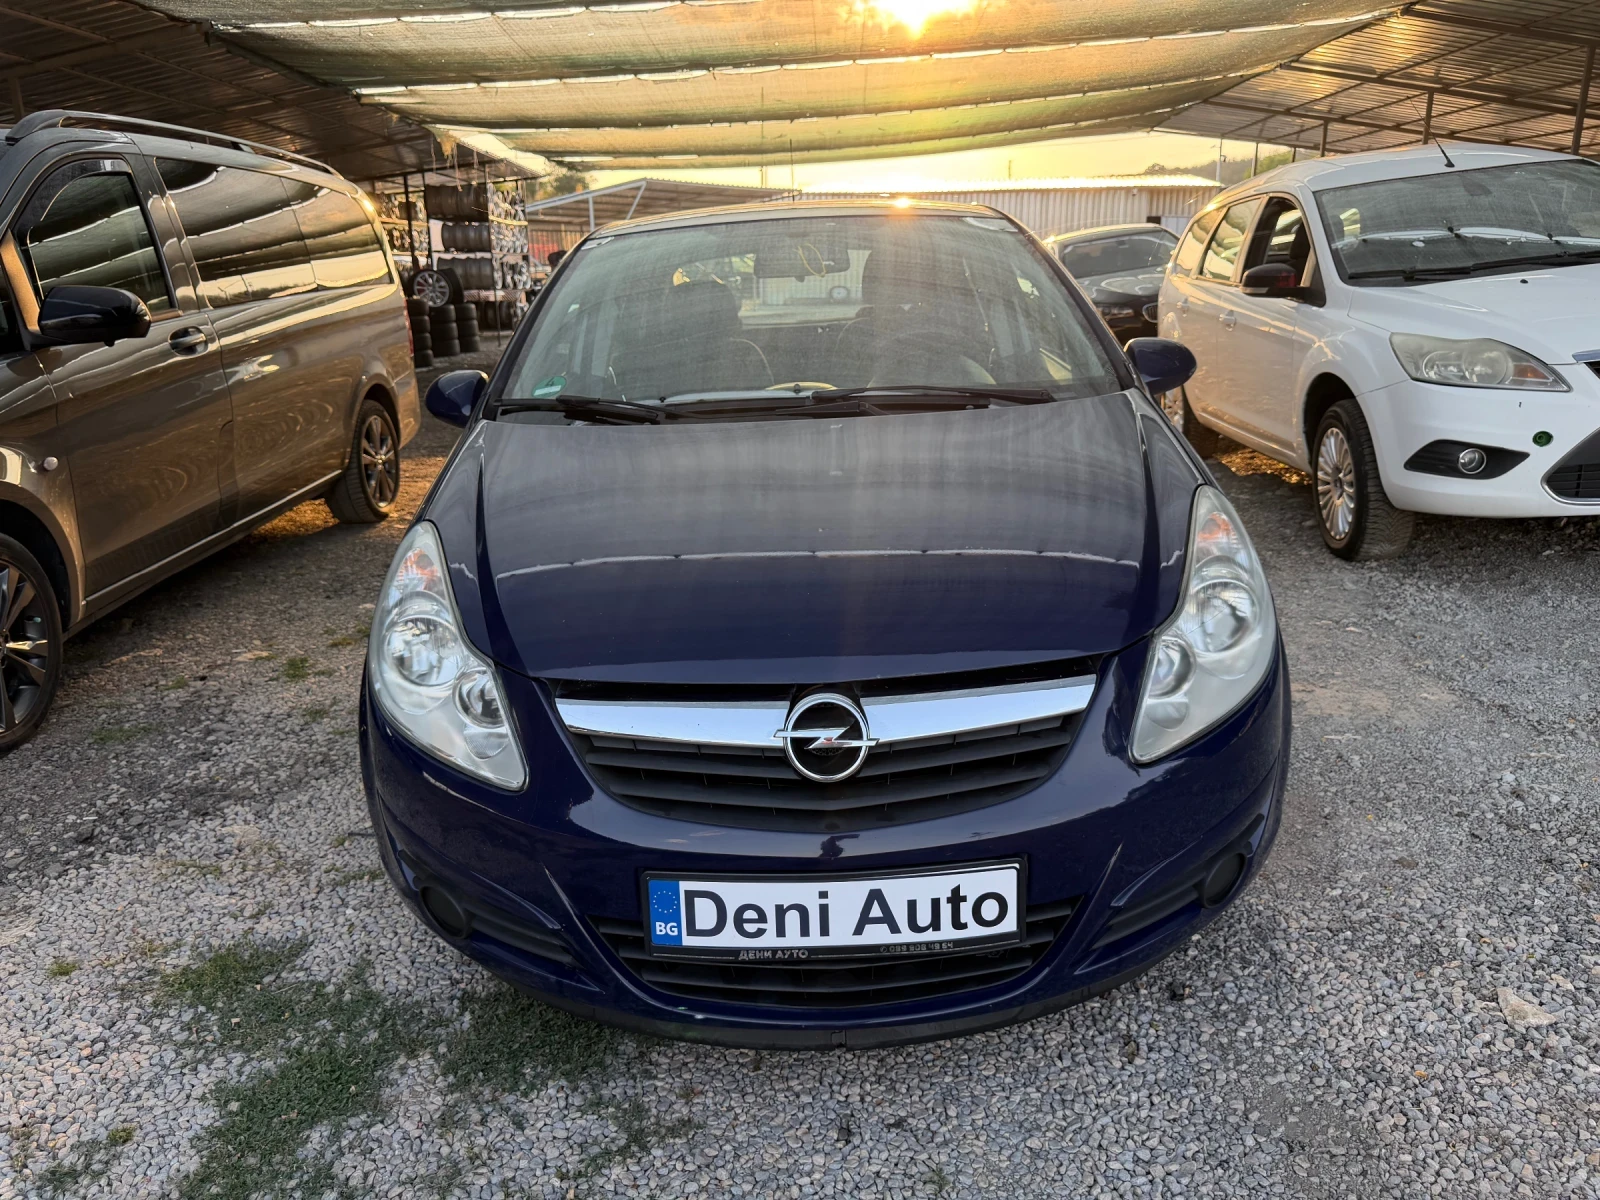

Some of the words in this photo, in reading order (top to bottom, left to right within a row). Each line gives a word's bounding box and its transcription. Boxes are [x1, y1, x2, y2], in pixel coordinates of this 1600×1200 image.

[683, 890, 830, 939] Deni
[851, 883, 1009, 936] Auto
[655, 922, 679, 936] BG
[738, 950, 773, 960] ДЕНИ
[775, 949, 809, 959] АУТО
